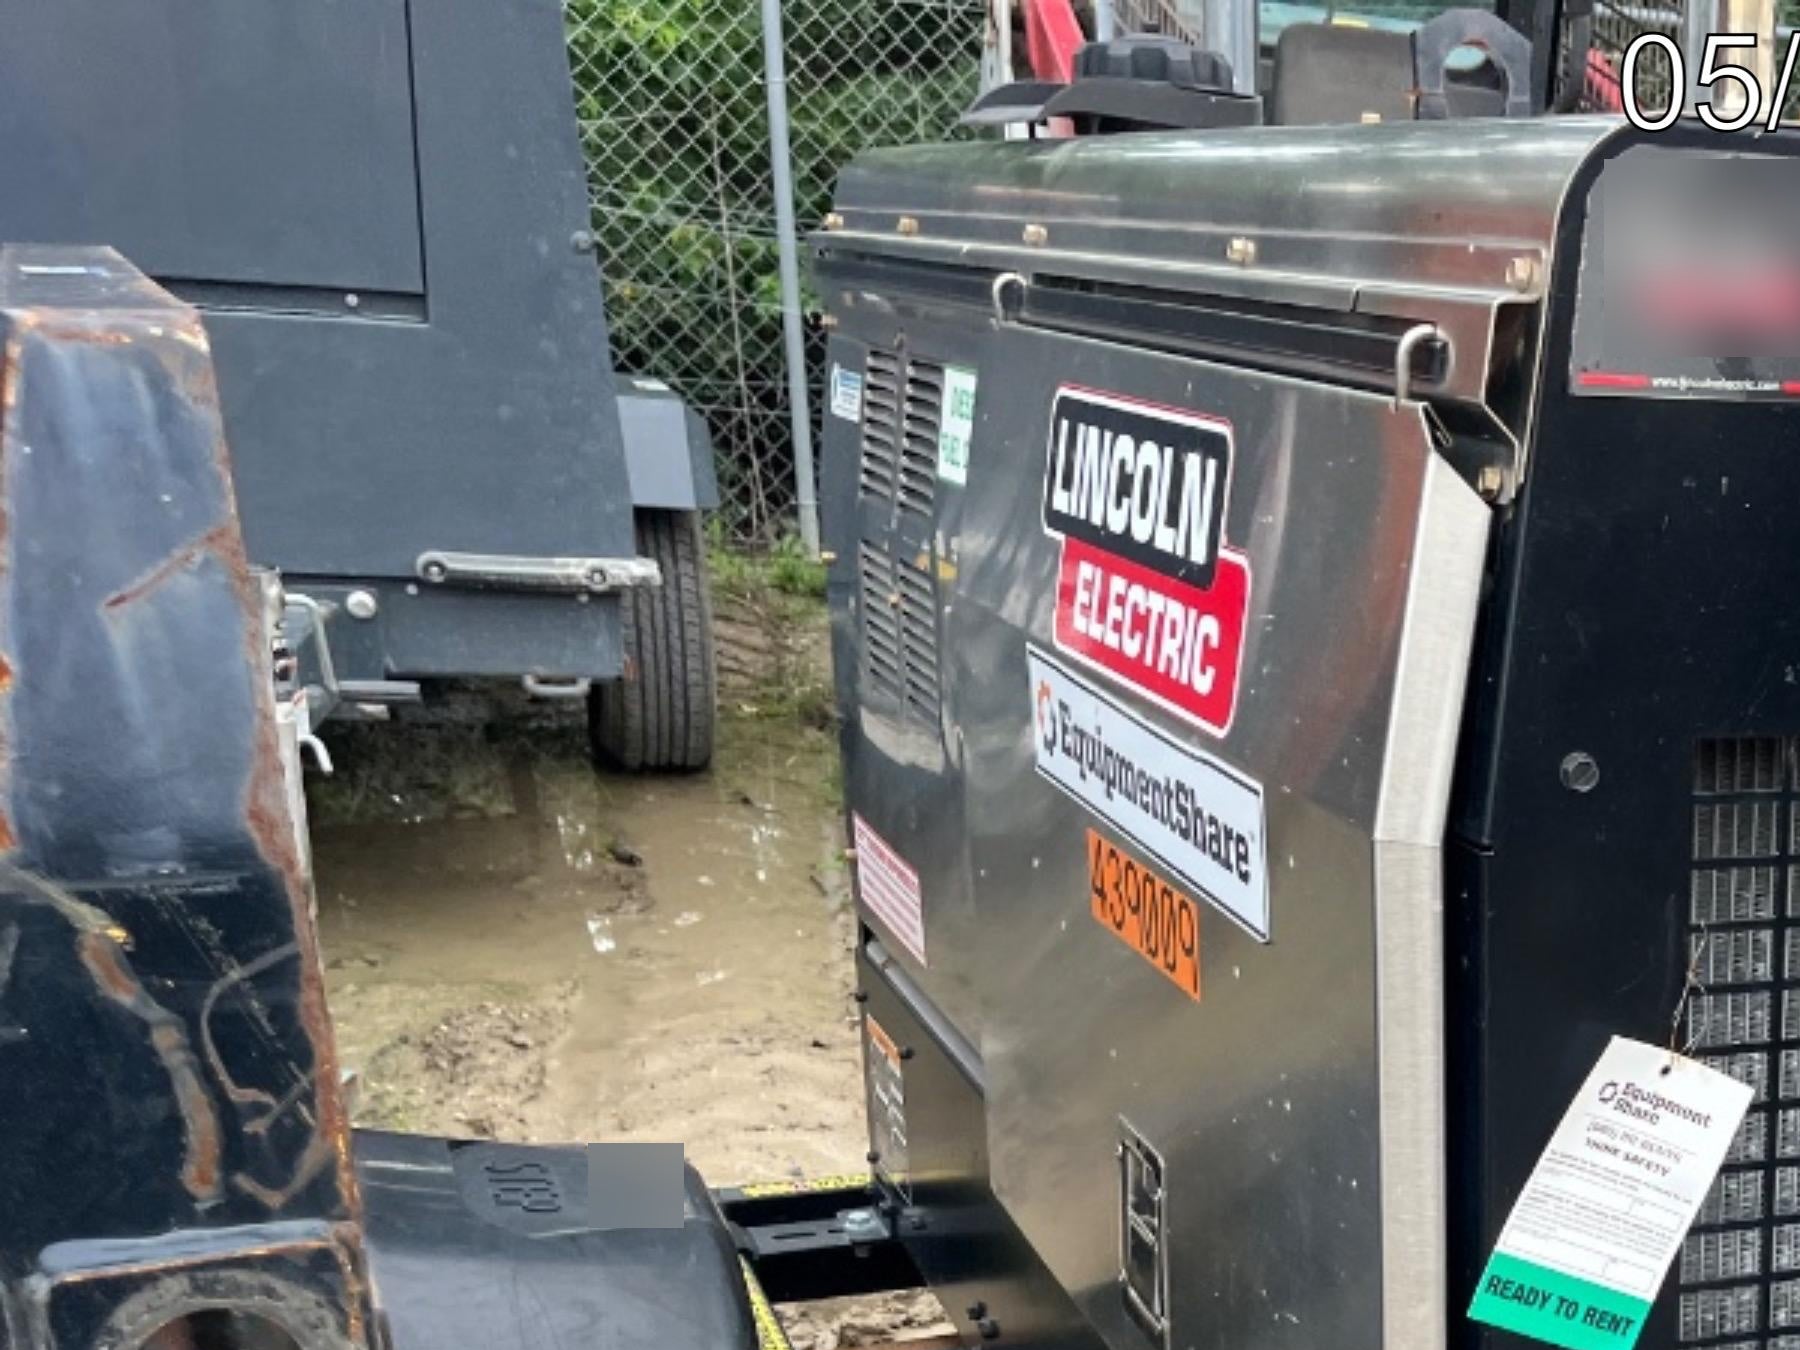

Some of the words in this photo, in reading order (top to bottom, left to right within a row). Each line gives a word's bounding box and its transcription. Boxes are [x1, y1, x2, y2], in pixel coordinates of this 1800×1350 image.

[1052, 418, 1217, 564] LINCOLN
[1073, 560, 1219, 696] ELECTRIC
[1059, 699, 1250, 884] EquipmentShare
[1092, 839, 1198, 993] 439009
[1613, 1098, 1660, 1126] Share
[1622, 1082, 1713, 1128] Equipment
[1485, 1274, 1553, 1311] READY
[1555, 1295, 1579, 1320] TO
[1584, 1307, 1635, 1336] RENT
